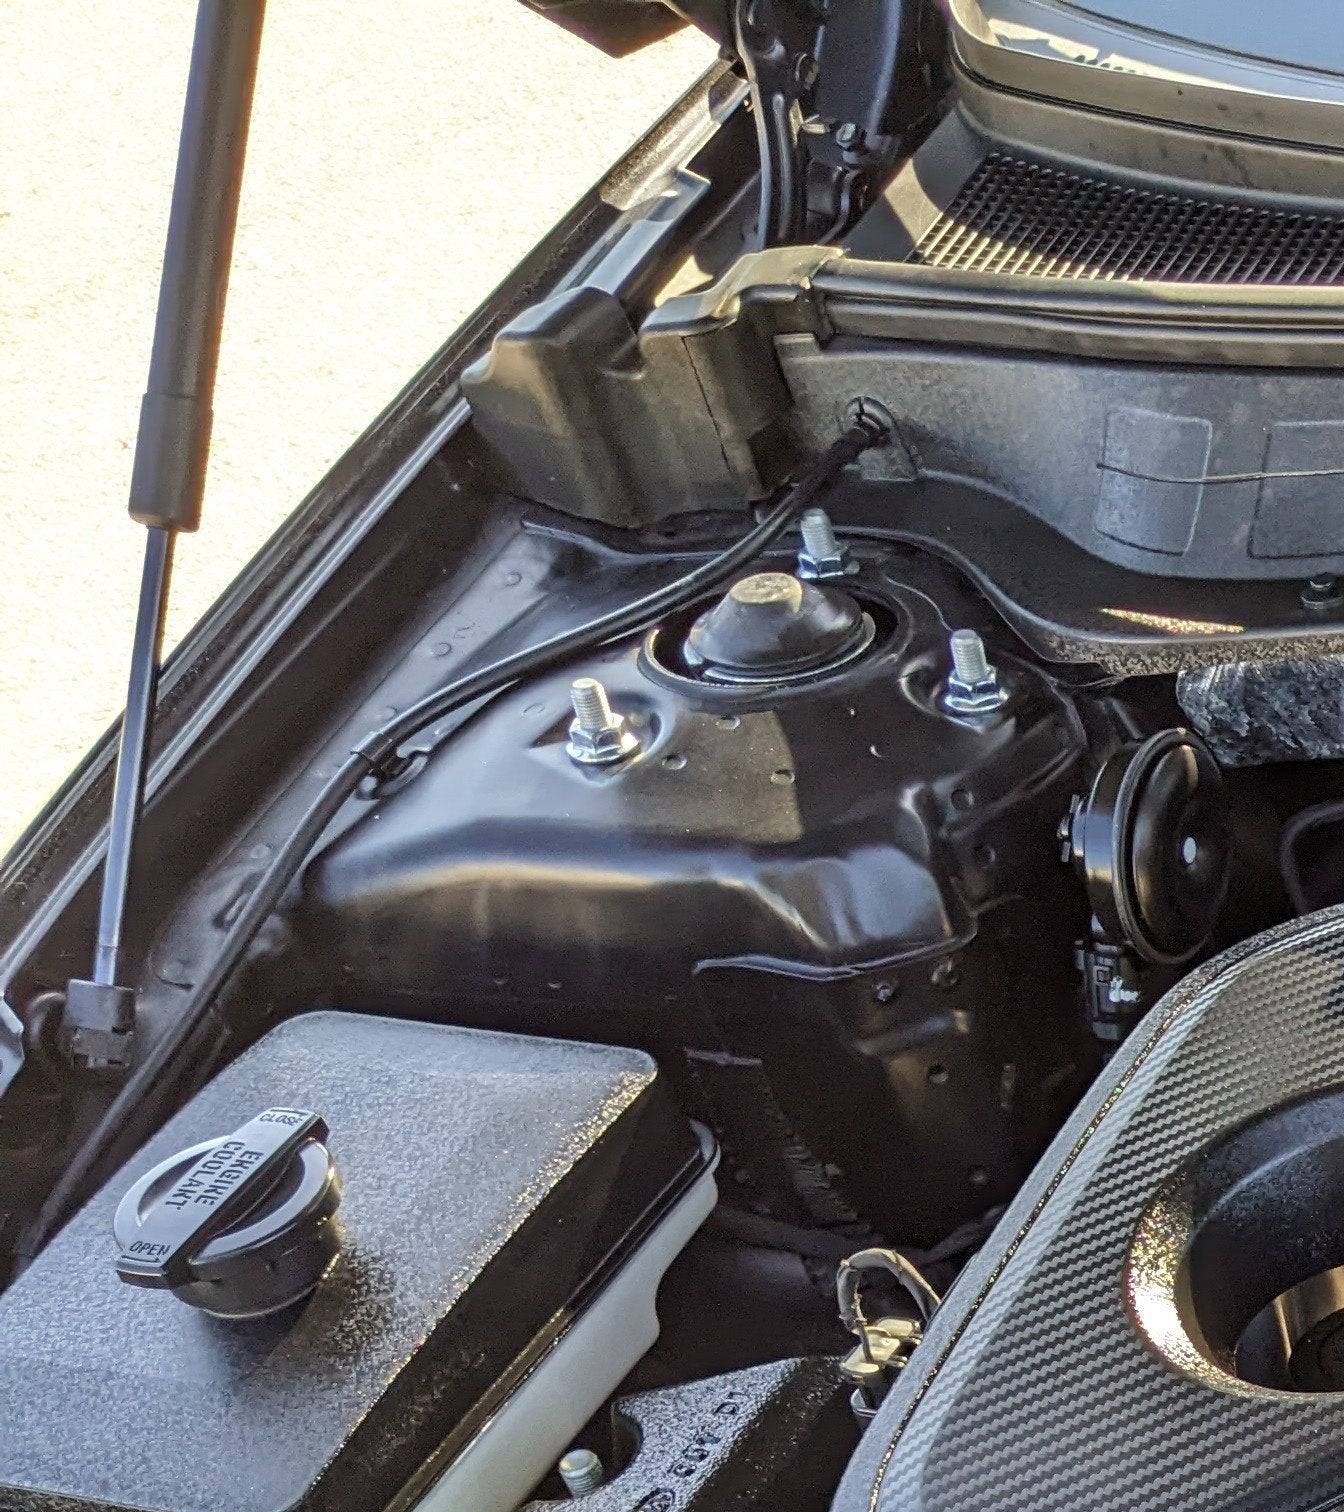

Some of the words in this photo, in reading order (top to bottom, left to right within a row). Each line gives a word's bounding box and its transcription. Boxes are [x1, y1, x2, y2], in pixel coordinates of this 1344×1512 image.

[259, 1113, 304, 1127] CLOSE
[165, 1141, 245, 1210] COOLANT
[194, 1150, 264, 1206] ENGINE
[130, 1240, 170, 1256] OPEN
